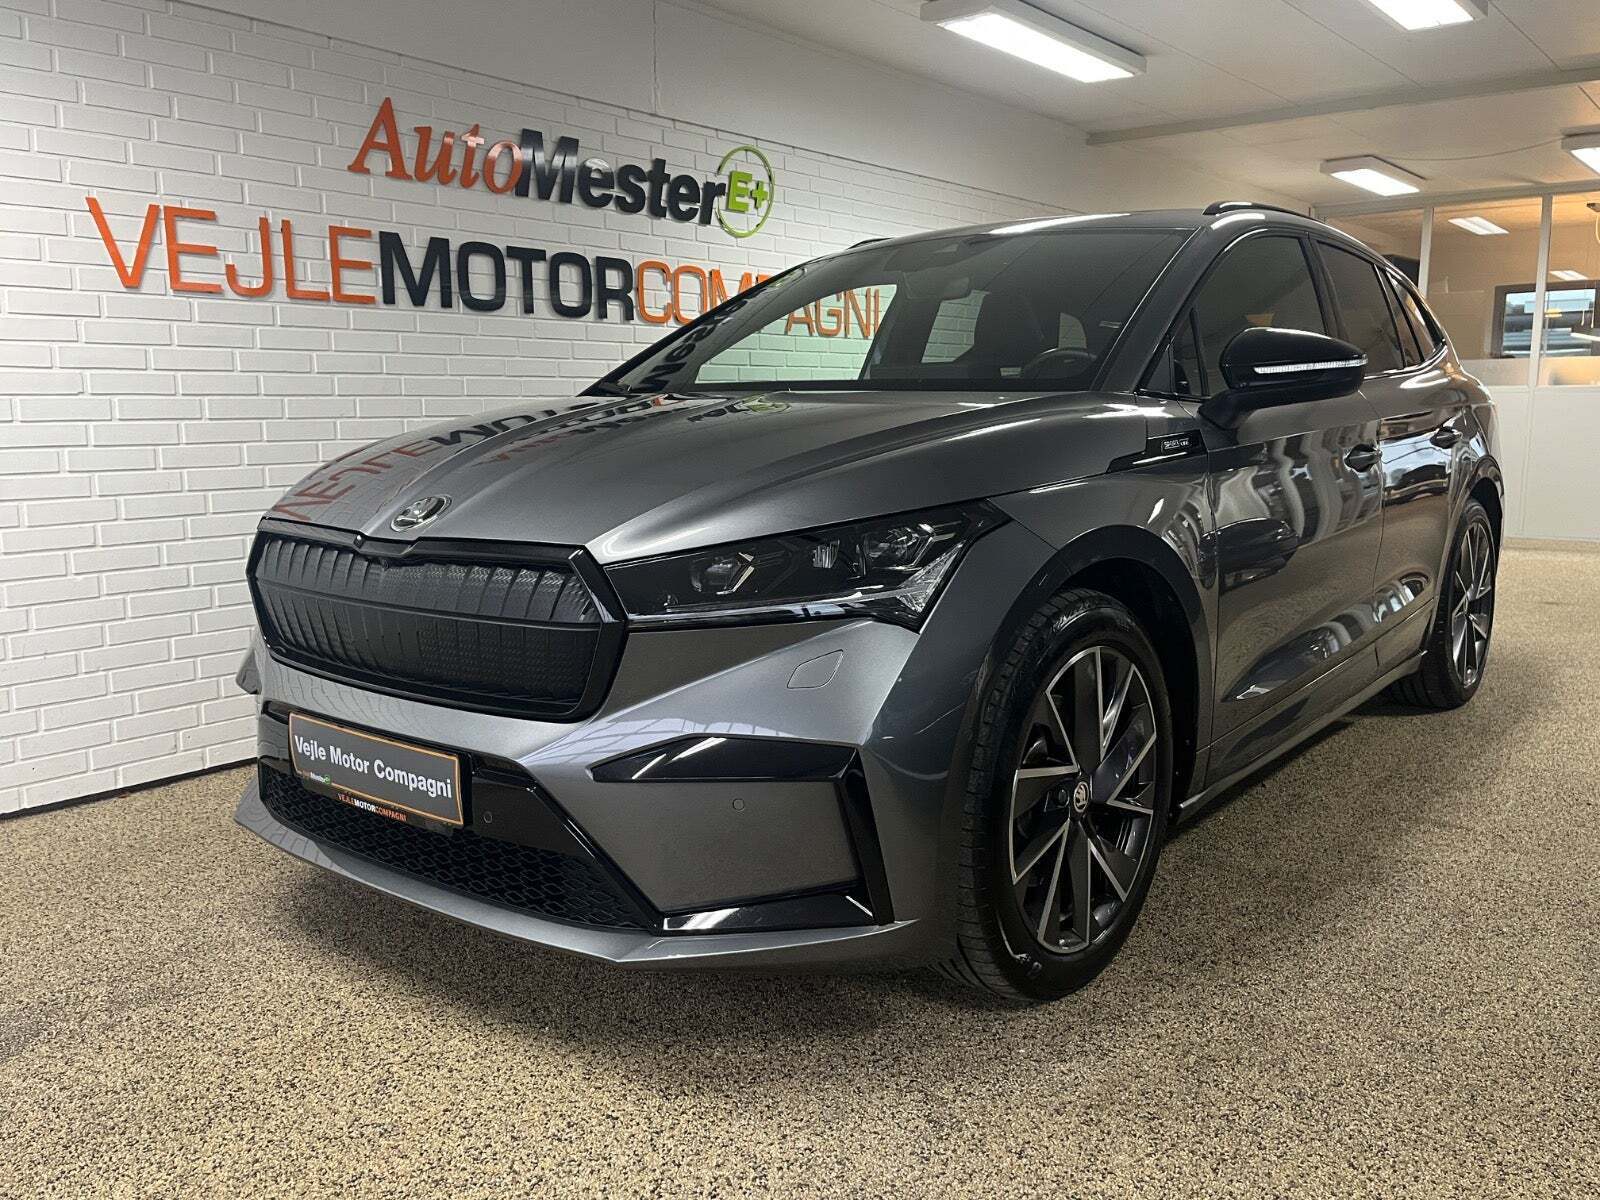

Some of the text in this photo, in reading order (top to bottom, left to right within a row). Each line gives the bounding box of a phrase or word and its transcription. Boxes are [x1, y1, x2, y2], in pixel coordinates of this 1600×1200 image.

[347, 97, 726, 226] AutoMester
[294, 735, 453, 798] Vejle Motor Compagni
